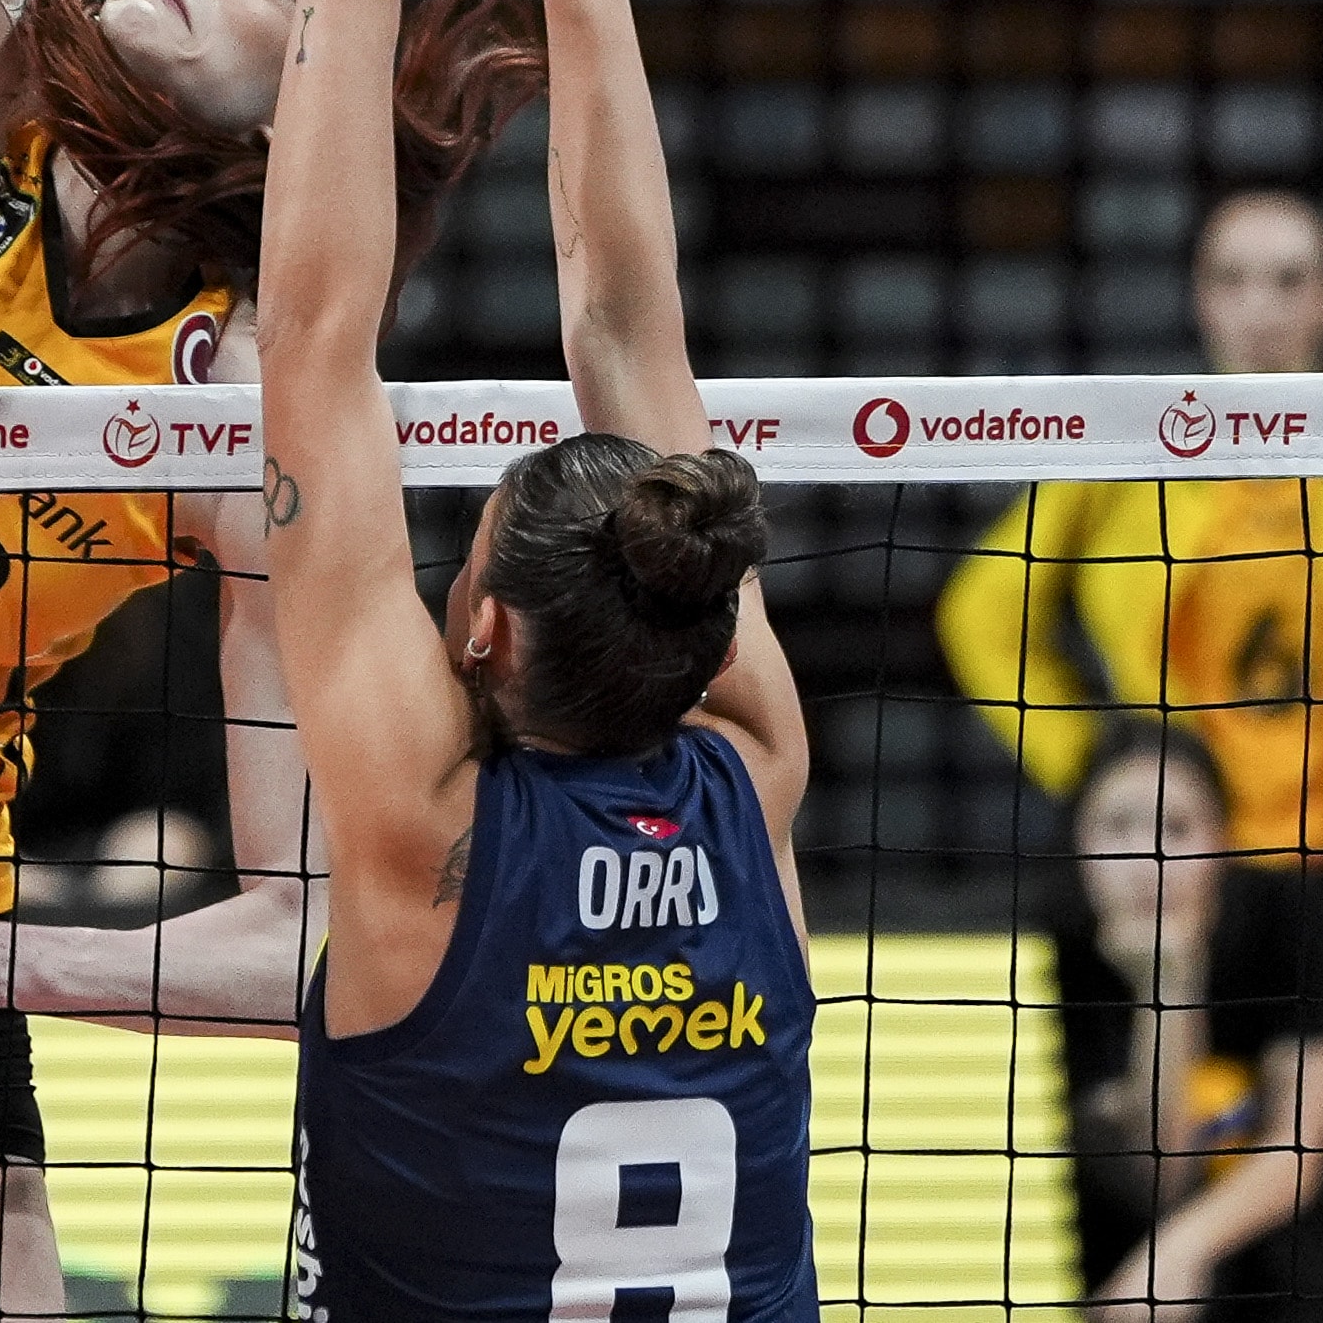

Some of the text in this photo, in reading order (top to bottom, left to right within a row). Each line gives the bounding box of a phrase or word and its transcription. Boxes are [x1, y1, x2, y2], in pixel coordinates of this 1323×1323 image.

[169, 422, 253, 457] TVF
[395, 412, 559, 445] vodafone
[920, 408, 1085, 441] vodafone
[1225, 412, 1308, 446] TVF
[18, 492, 114, 560] ank
[523, 981, 766, 1075] yemek
[548, 1097, 737, 1323] 8
